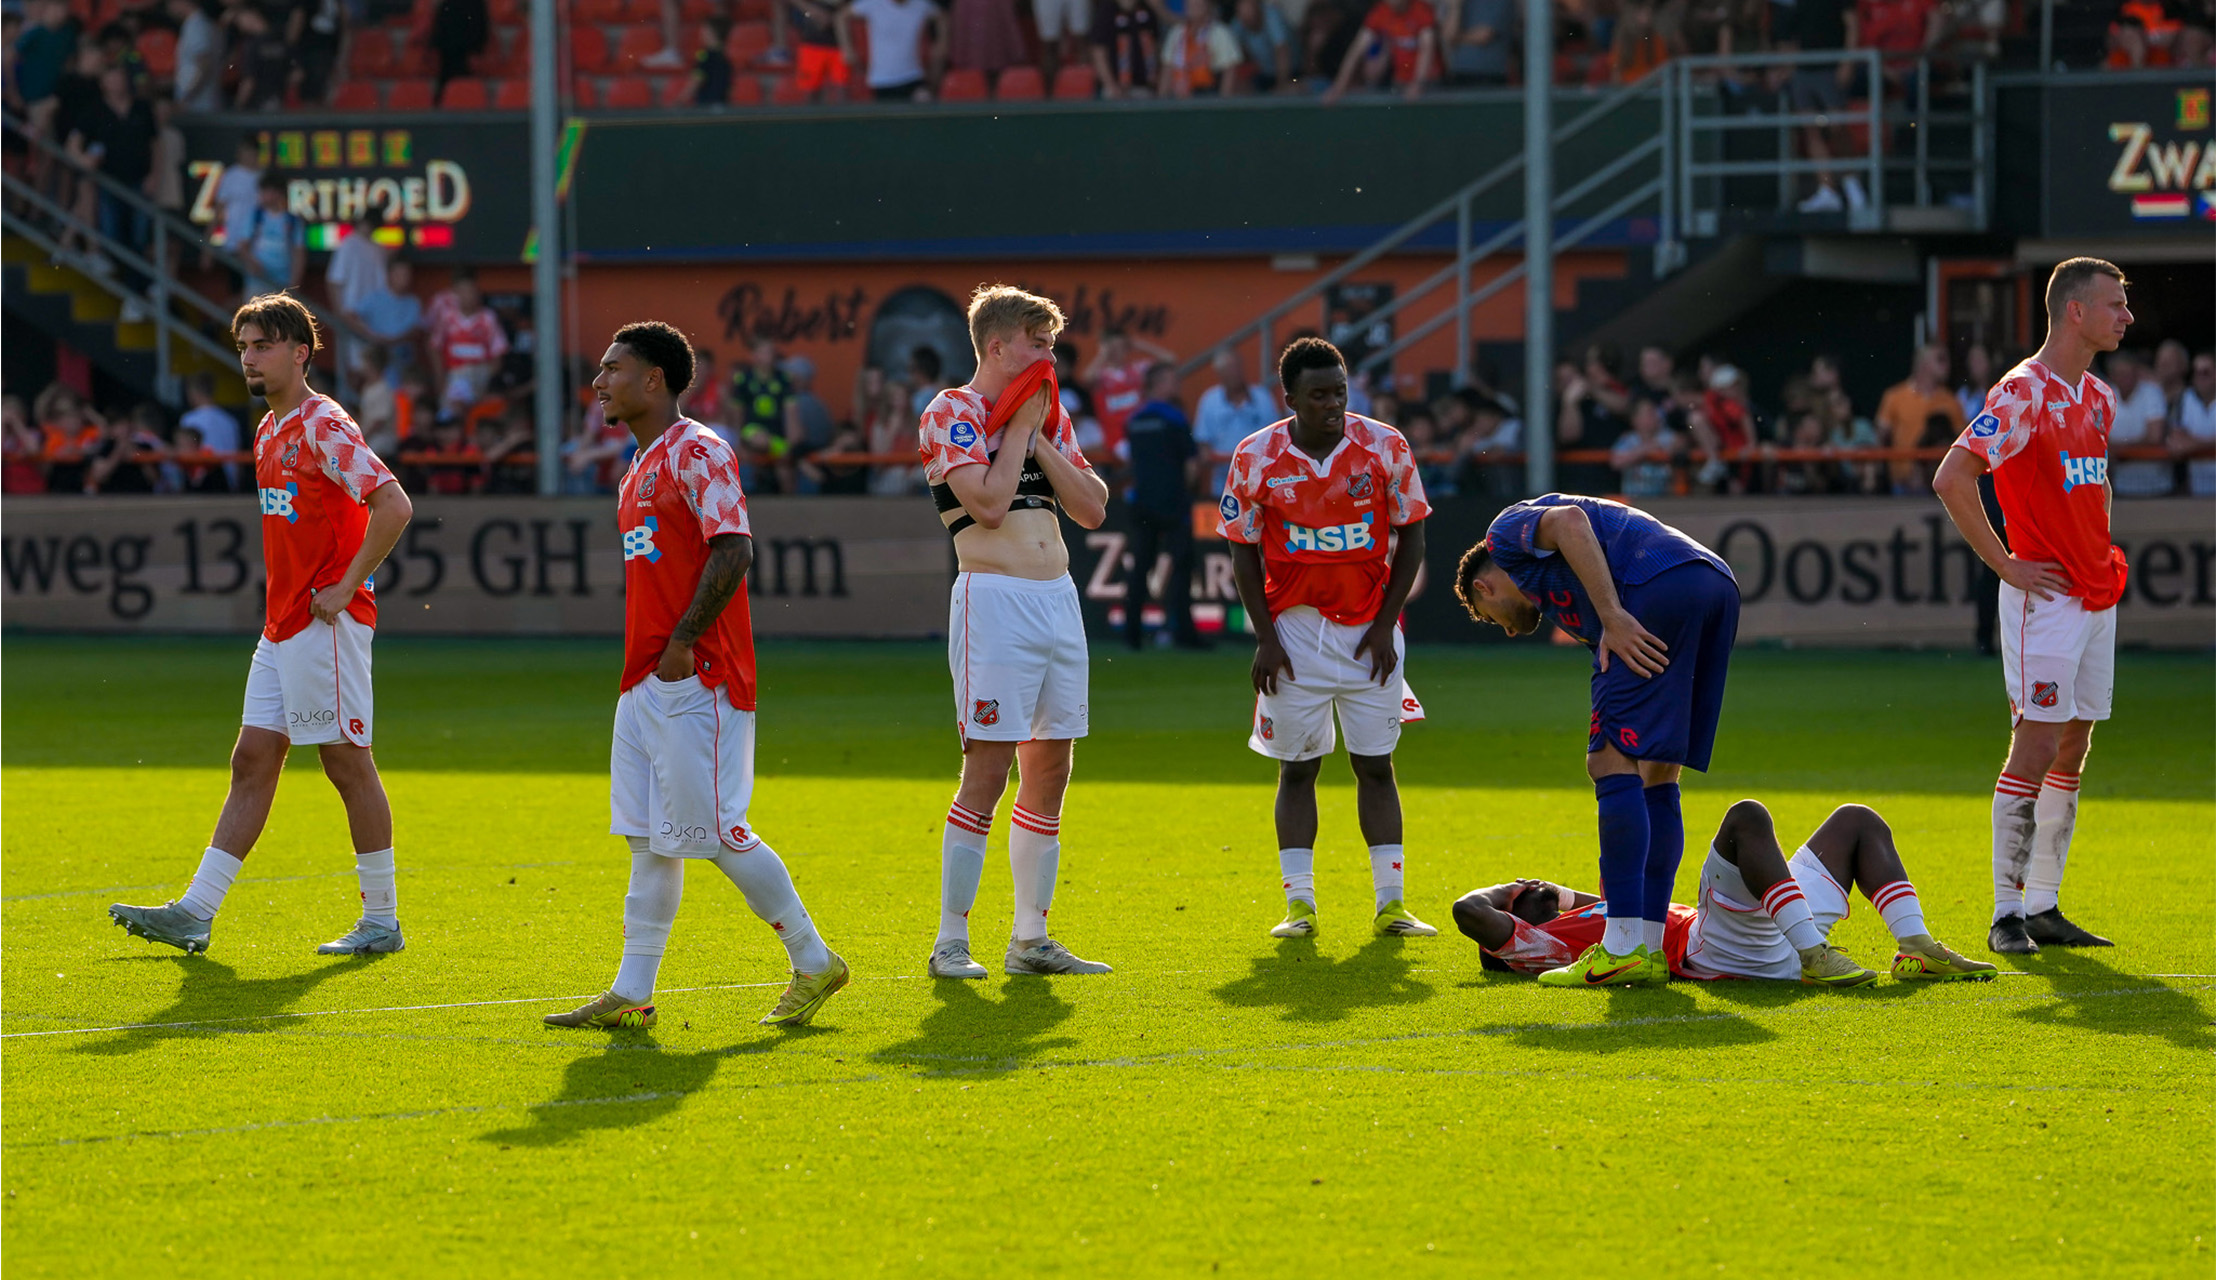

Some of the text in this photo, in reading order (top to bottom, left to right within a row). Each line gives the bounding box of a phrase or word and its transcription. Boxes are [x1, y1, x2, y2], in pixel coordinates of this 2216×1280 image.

[188, 160, 472, 223] ZRTHOED
[471, 517, 590, 597] GH
[624, 525, 655, 562] SB
[1289, 521, 1371, 552] HSB
